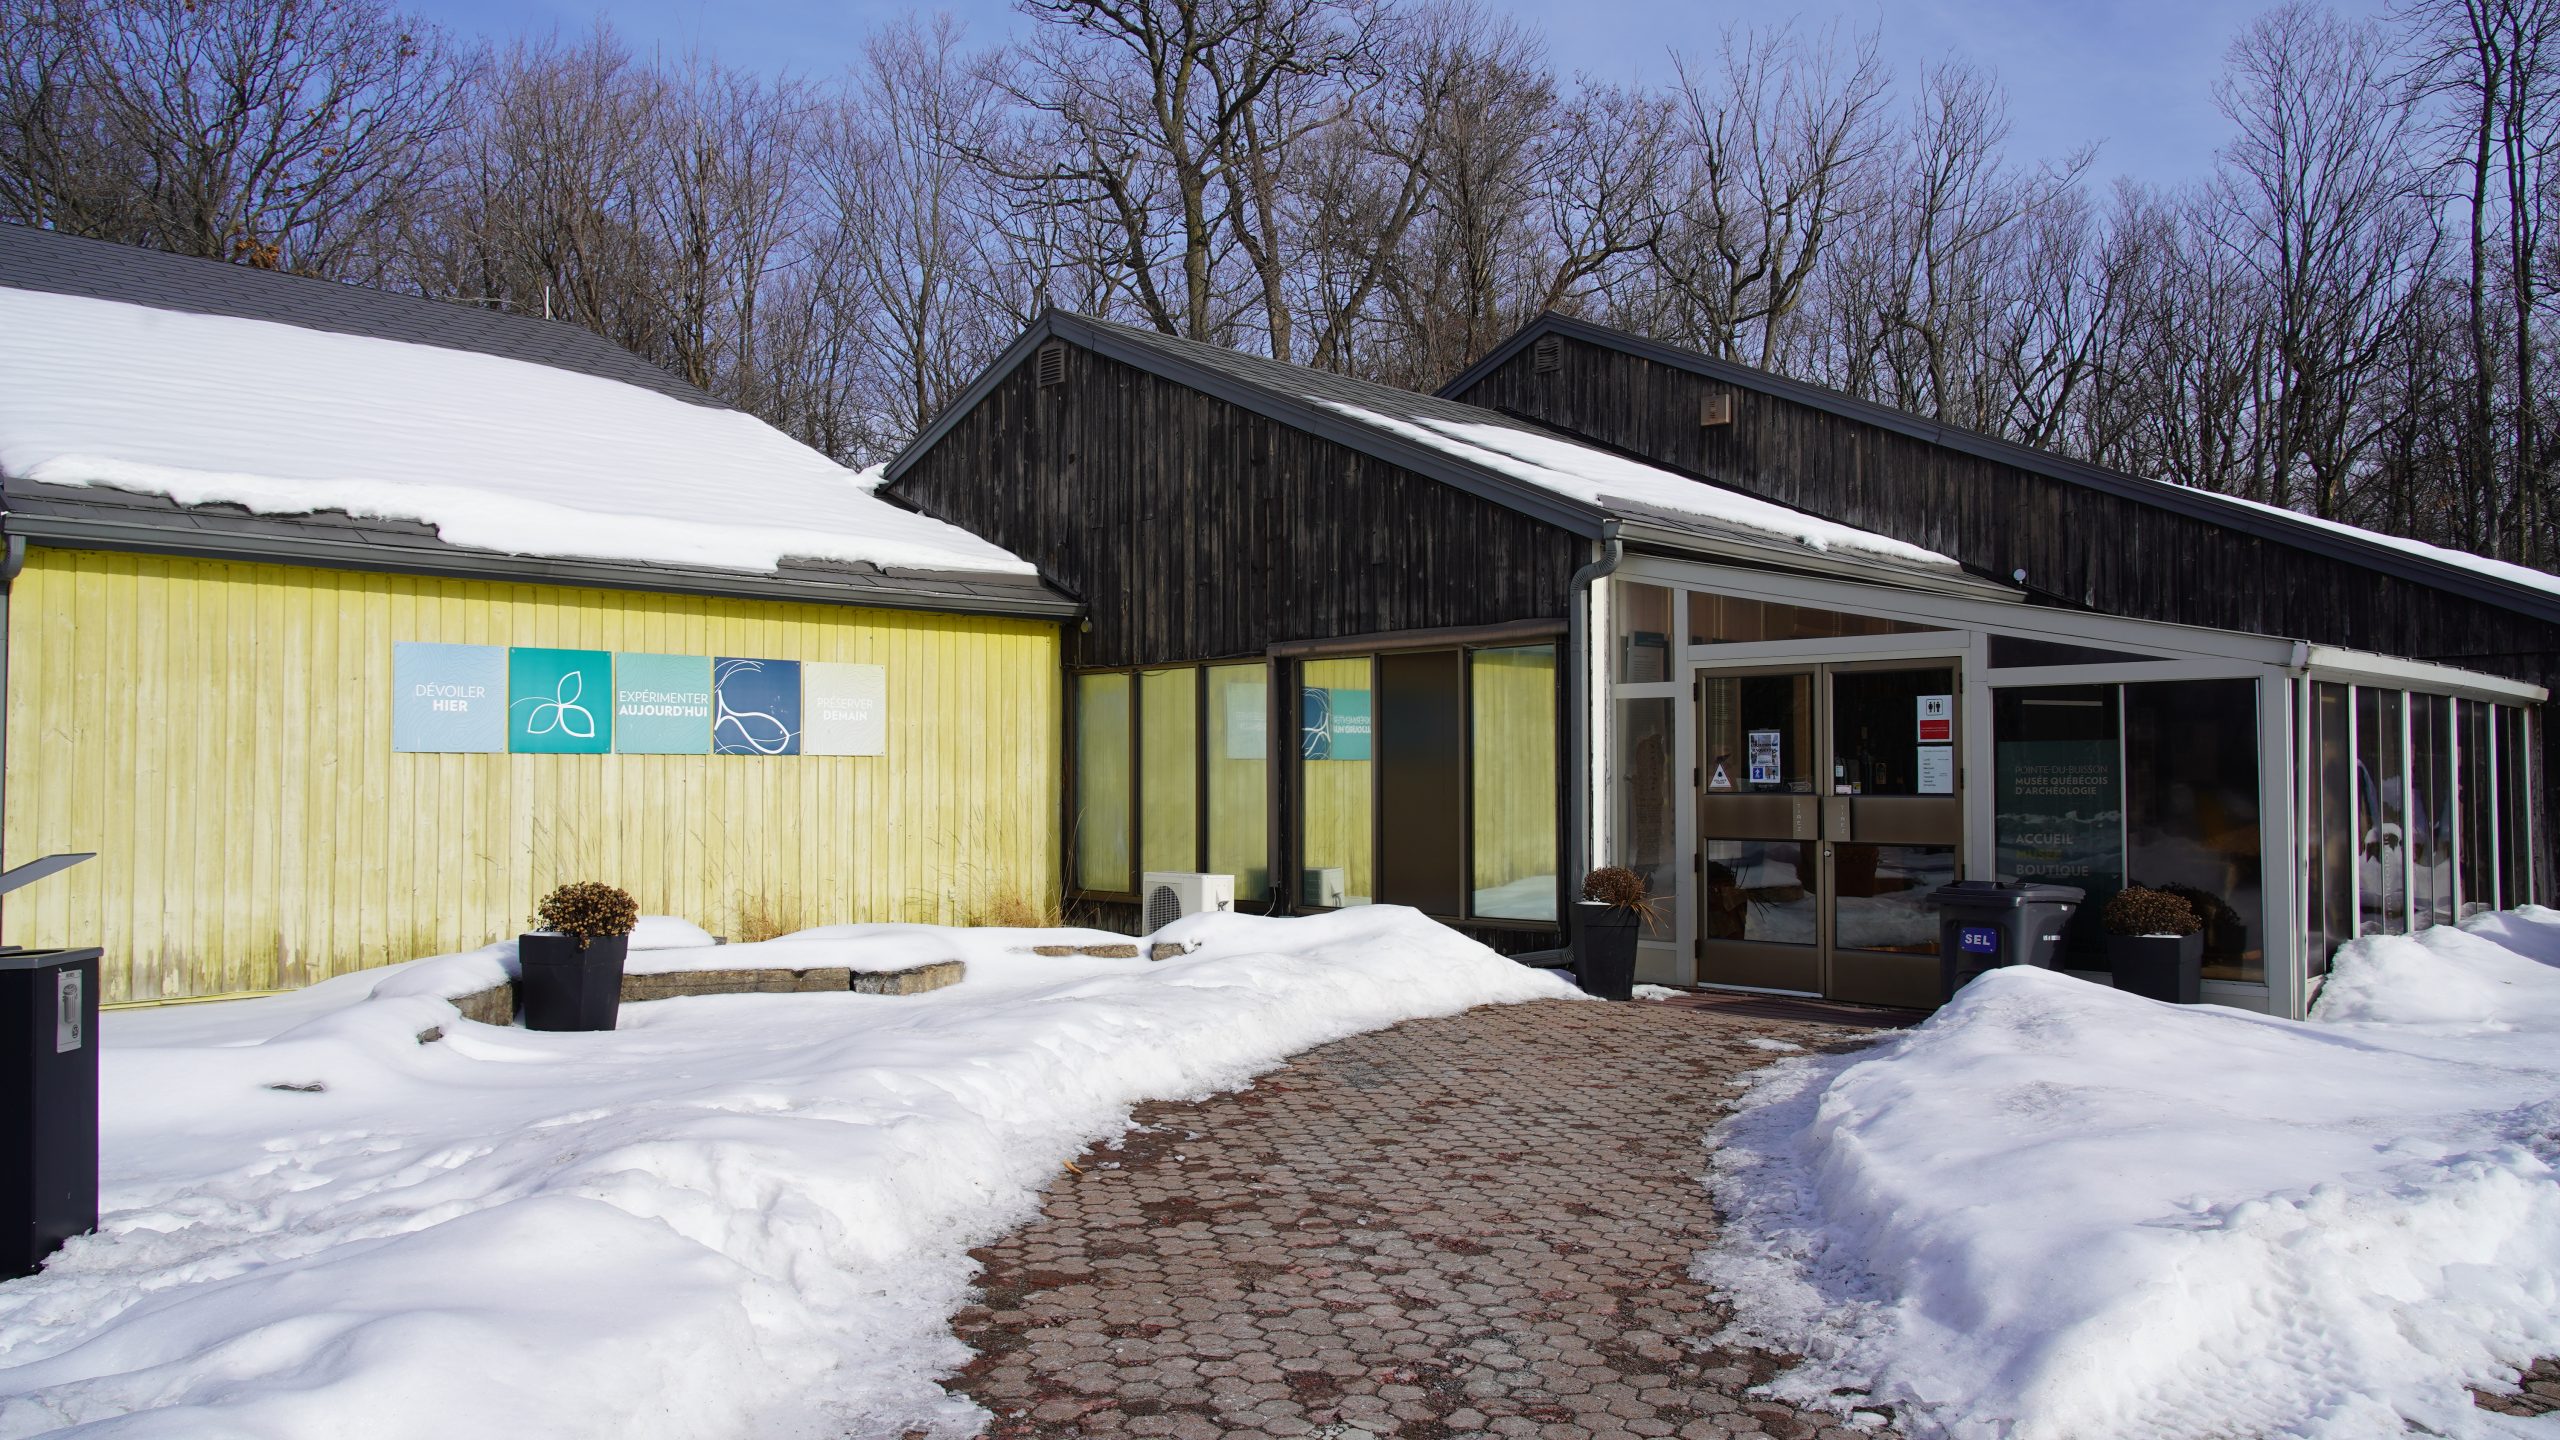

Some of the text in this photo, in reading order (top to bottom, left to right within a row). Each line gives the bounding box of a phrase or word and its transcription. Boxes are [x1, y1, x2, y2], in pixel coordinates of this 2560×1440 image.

[415, 682, 486, 699] DÉVOILER
[618, 689, 709, 705] EXPÉRIMENTER
[432, 699, 469, 712] HIER
[816, 696, 873, 709] PRÉSERVER
[618, 705, 708, 718] AUJOURD'HUI
[823, 710, 868, 721] DEMAIN
[2015, 775, 2109, 786] MUSÉE QUÉBÉCOIS
[2015, 785, 2097, 795] D'ARCHÉOLOGIE
[2015, 833, 2074, 845] ACCUEIL
[2015, 864, 2090, 877] BOUTIQUE
[1964, 934, 1991, 946] SEL
